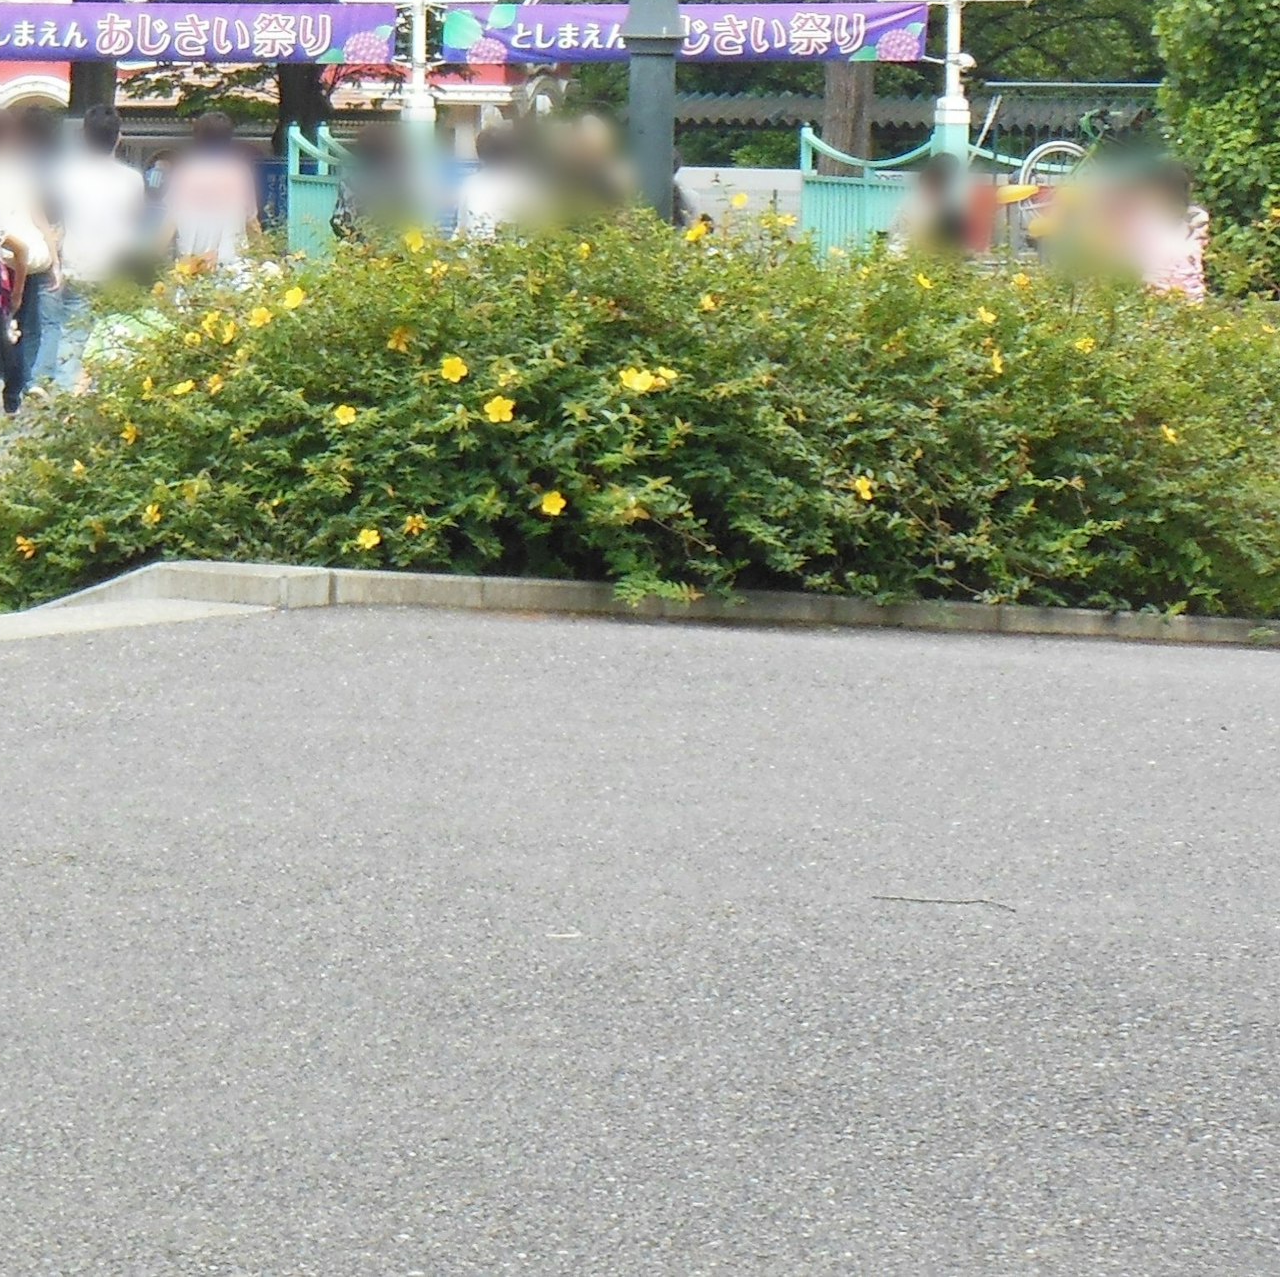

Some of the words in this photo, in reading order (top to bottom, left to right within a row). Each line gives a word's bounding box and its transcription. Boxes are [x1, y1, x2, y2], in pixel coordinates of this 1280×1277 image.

[95, 12, 332, 57] あじさい祭り
[679, 12, 866, 55] じさい祭り
